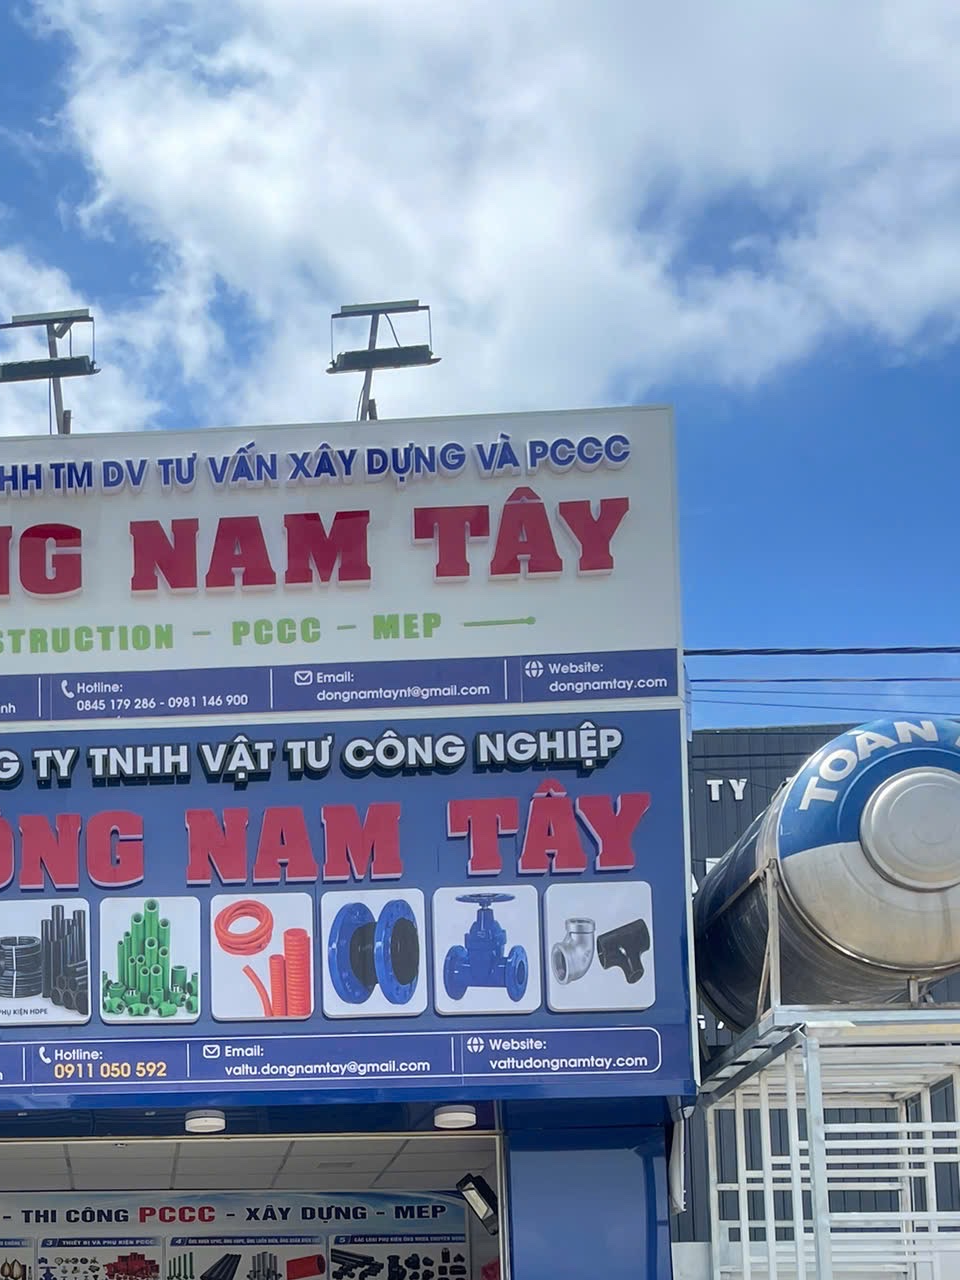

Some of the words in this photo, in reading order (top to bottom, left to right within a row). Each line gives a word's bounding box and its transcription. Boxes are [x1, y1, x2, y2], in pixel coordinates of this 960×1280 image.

[49, 456, 93, 494] TM
[102, 459, 149, 488] DV
[158, 453, 197, 485] TƯ
[208, 440, 277, 486] VẤN
[290, 440, 357, 481] XÂY
[366, 442, 466, 488] DỰNG
[476, 433, 520, 476] VÀ
[528, 434, 630, 470] PCCC
[130, 510, 371, 594] NAM
[413, 487, 629, 581] TÂY
[233, 616, 321, 646] PCCC
[374, 612, 441, 640] MEP
[548, 661, 604, 674] Website:
[316, 671, 354, 684] Email:
[549, 676, 667, 694] dongnamtay.com
[76, 682, 123, 694] Hotline:
[316, 684, 490, 703] dongnamtaynt@gmail.com
[76, 699, 106, 711] 0845
[110, 698, 131, 710] 179
[134, 698, 156, 709] 286
[168, 696, 196, 708] 0981
[201, 695, 223, 707] 146
[226, 694, 248, 706] 900
[32, 749, 77, 780] TY
[91, 746, 188, 777] TNHH
[203, 736, 275, 784] VẬT
[286, 737, 331, 771] TƯ
[342, 730, 465, 771] CÔNG
[477, 721, 624, 770] NGHIỆP
[798, 720, 939, 811] TOÀN
[706, 779, 747, 801] TY
[185, 804, 403, 886] NAM
[446, 778, 652, 877] TÂY
[225, 1046, 264, 1058] Email:
[489, 1039, 547, 1051] Website:
[54, 1048, 103, 1062] Hotline:
[490, 1056, 647, 1070] vattudongnamtay.com
[54, 1063, 94, 1079] 0911
[100, 1063, 131, 1078] 050
[135, 1062, 167, 1078] 592
[225, 1059, 431, 1078] vattu.dongnamtay@gmail.com
[22, 1209, 57, 1223] THI
[65, 1203, 129, 1224] CÔNG
[140, 1207, 216, 1223] PCCC
[246, 1203, 291, 1221] XÂY
[301, 1204, 367, 1223] DỰNG
[395, 1205, 446, 1219] MEP
